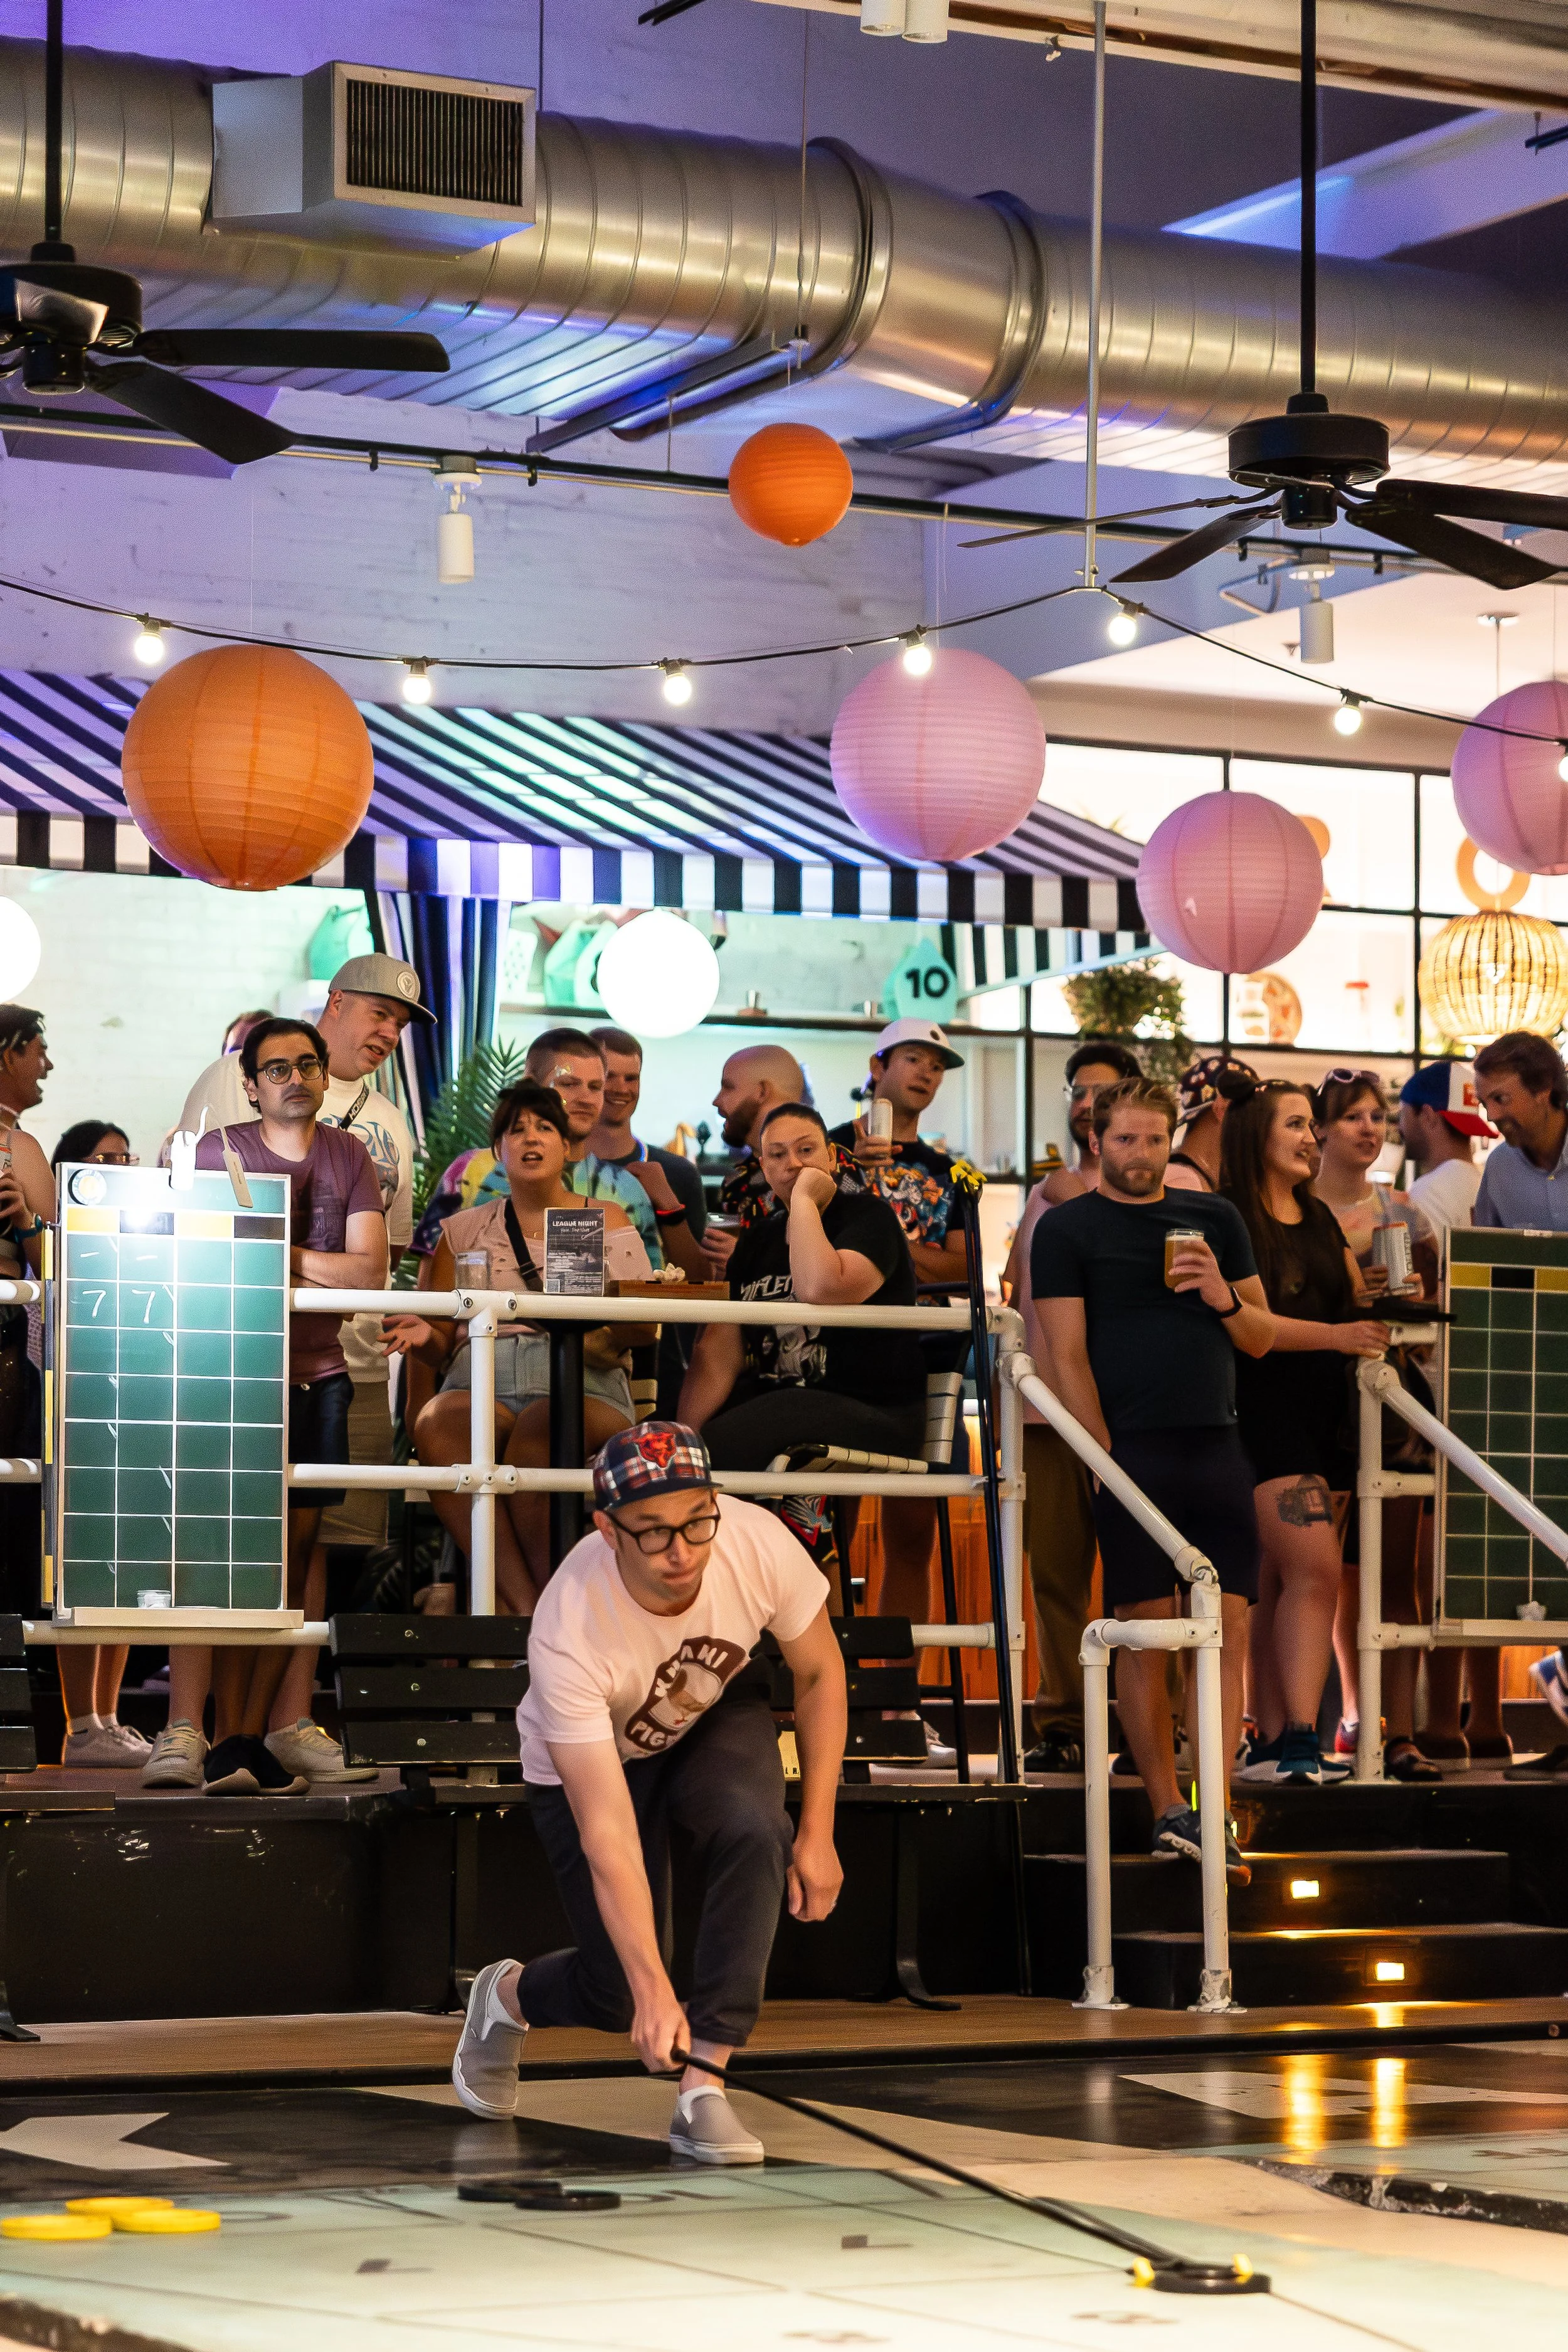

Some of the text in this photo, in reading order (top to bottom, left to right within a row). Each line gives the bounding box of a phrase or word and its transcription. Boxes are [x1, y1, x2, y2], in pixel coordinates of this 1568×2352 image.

[906, 967, 950, 999] 10
[82, 1290, 107, 1318] 7
[131, 1289, 156, 1324] 7
[630, 1720, 666, 1747] PIG
